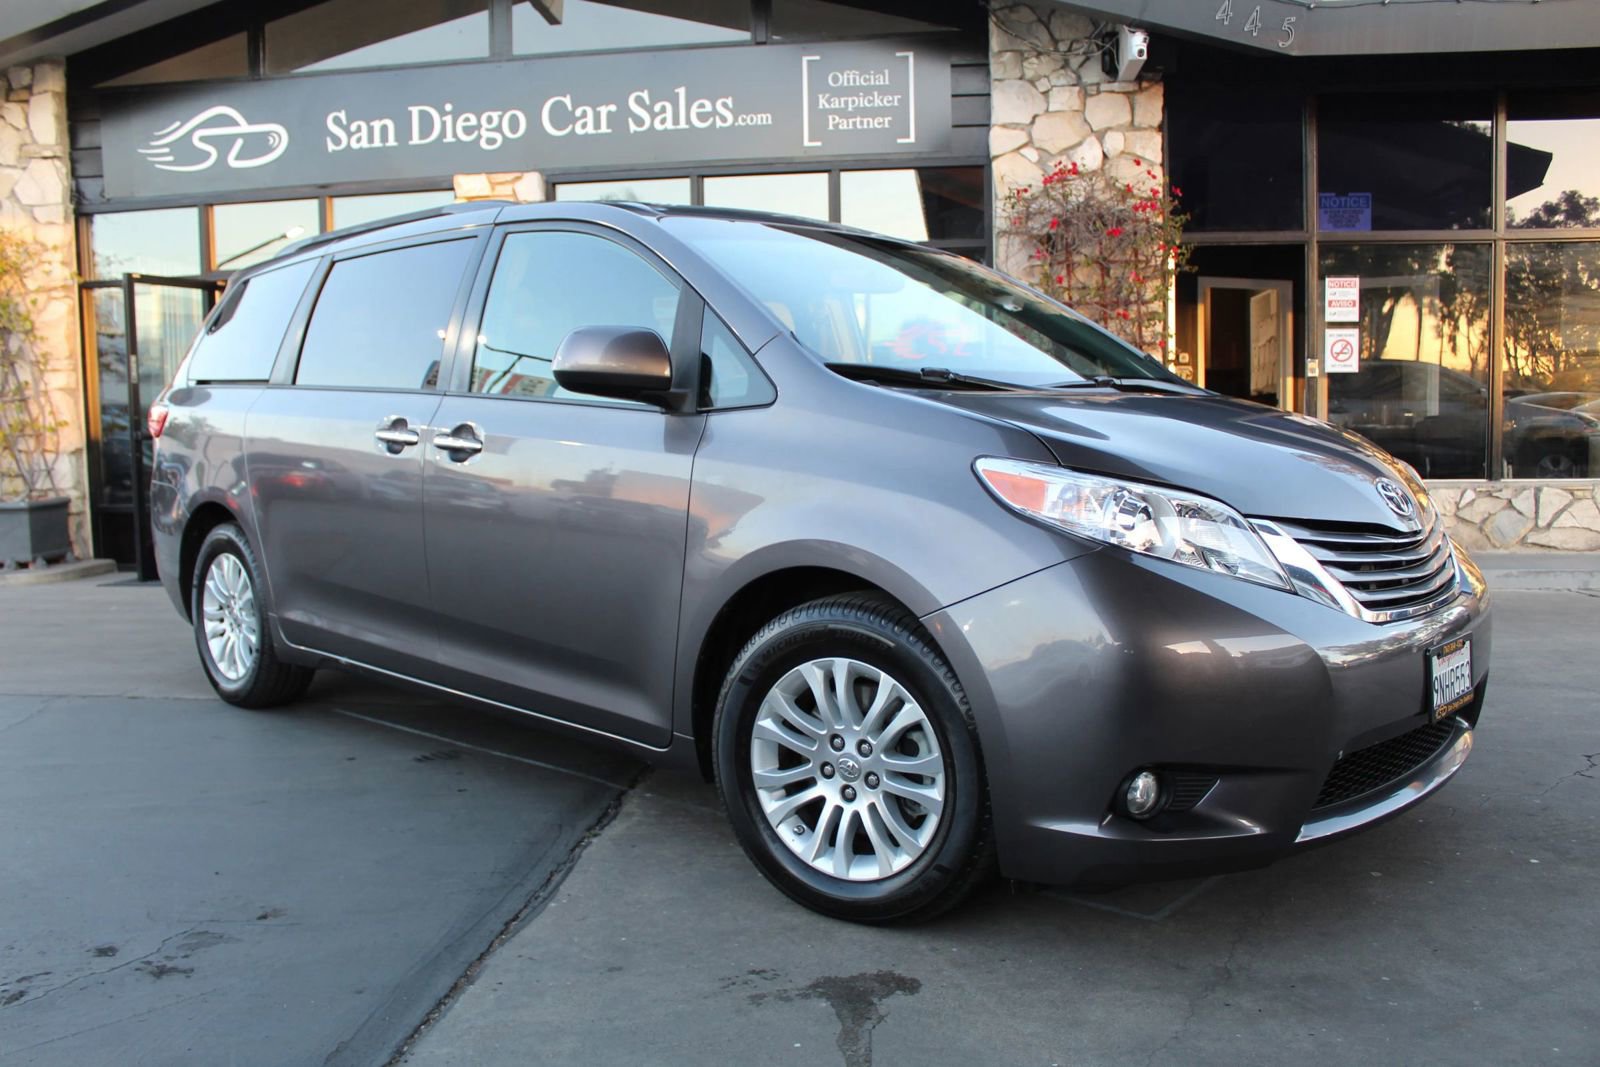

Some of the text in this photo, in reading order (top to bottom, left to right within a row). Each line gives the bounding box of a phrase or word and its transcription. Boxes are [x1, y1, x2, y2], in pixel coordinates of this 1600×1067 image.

[828, 69, 890, 87] Official
[818, 91, 902, 112] Karpicker
[326, 109, 398, 153] San
[408, 102, 527, 150] Diego
[541, 93, 617, 137] Car
[827, 114, 892, 130] Partner
[1321, 196, 1368, 208] NOTICE
[1328, 280, 1357, 289] NOTICE
[1330, 300, 1354, 308] AVISO
[1433, 660, 1470, 707] 9NHR553
